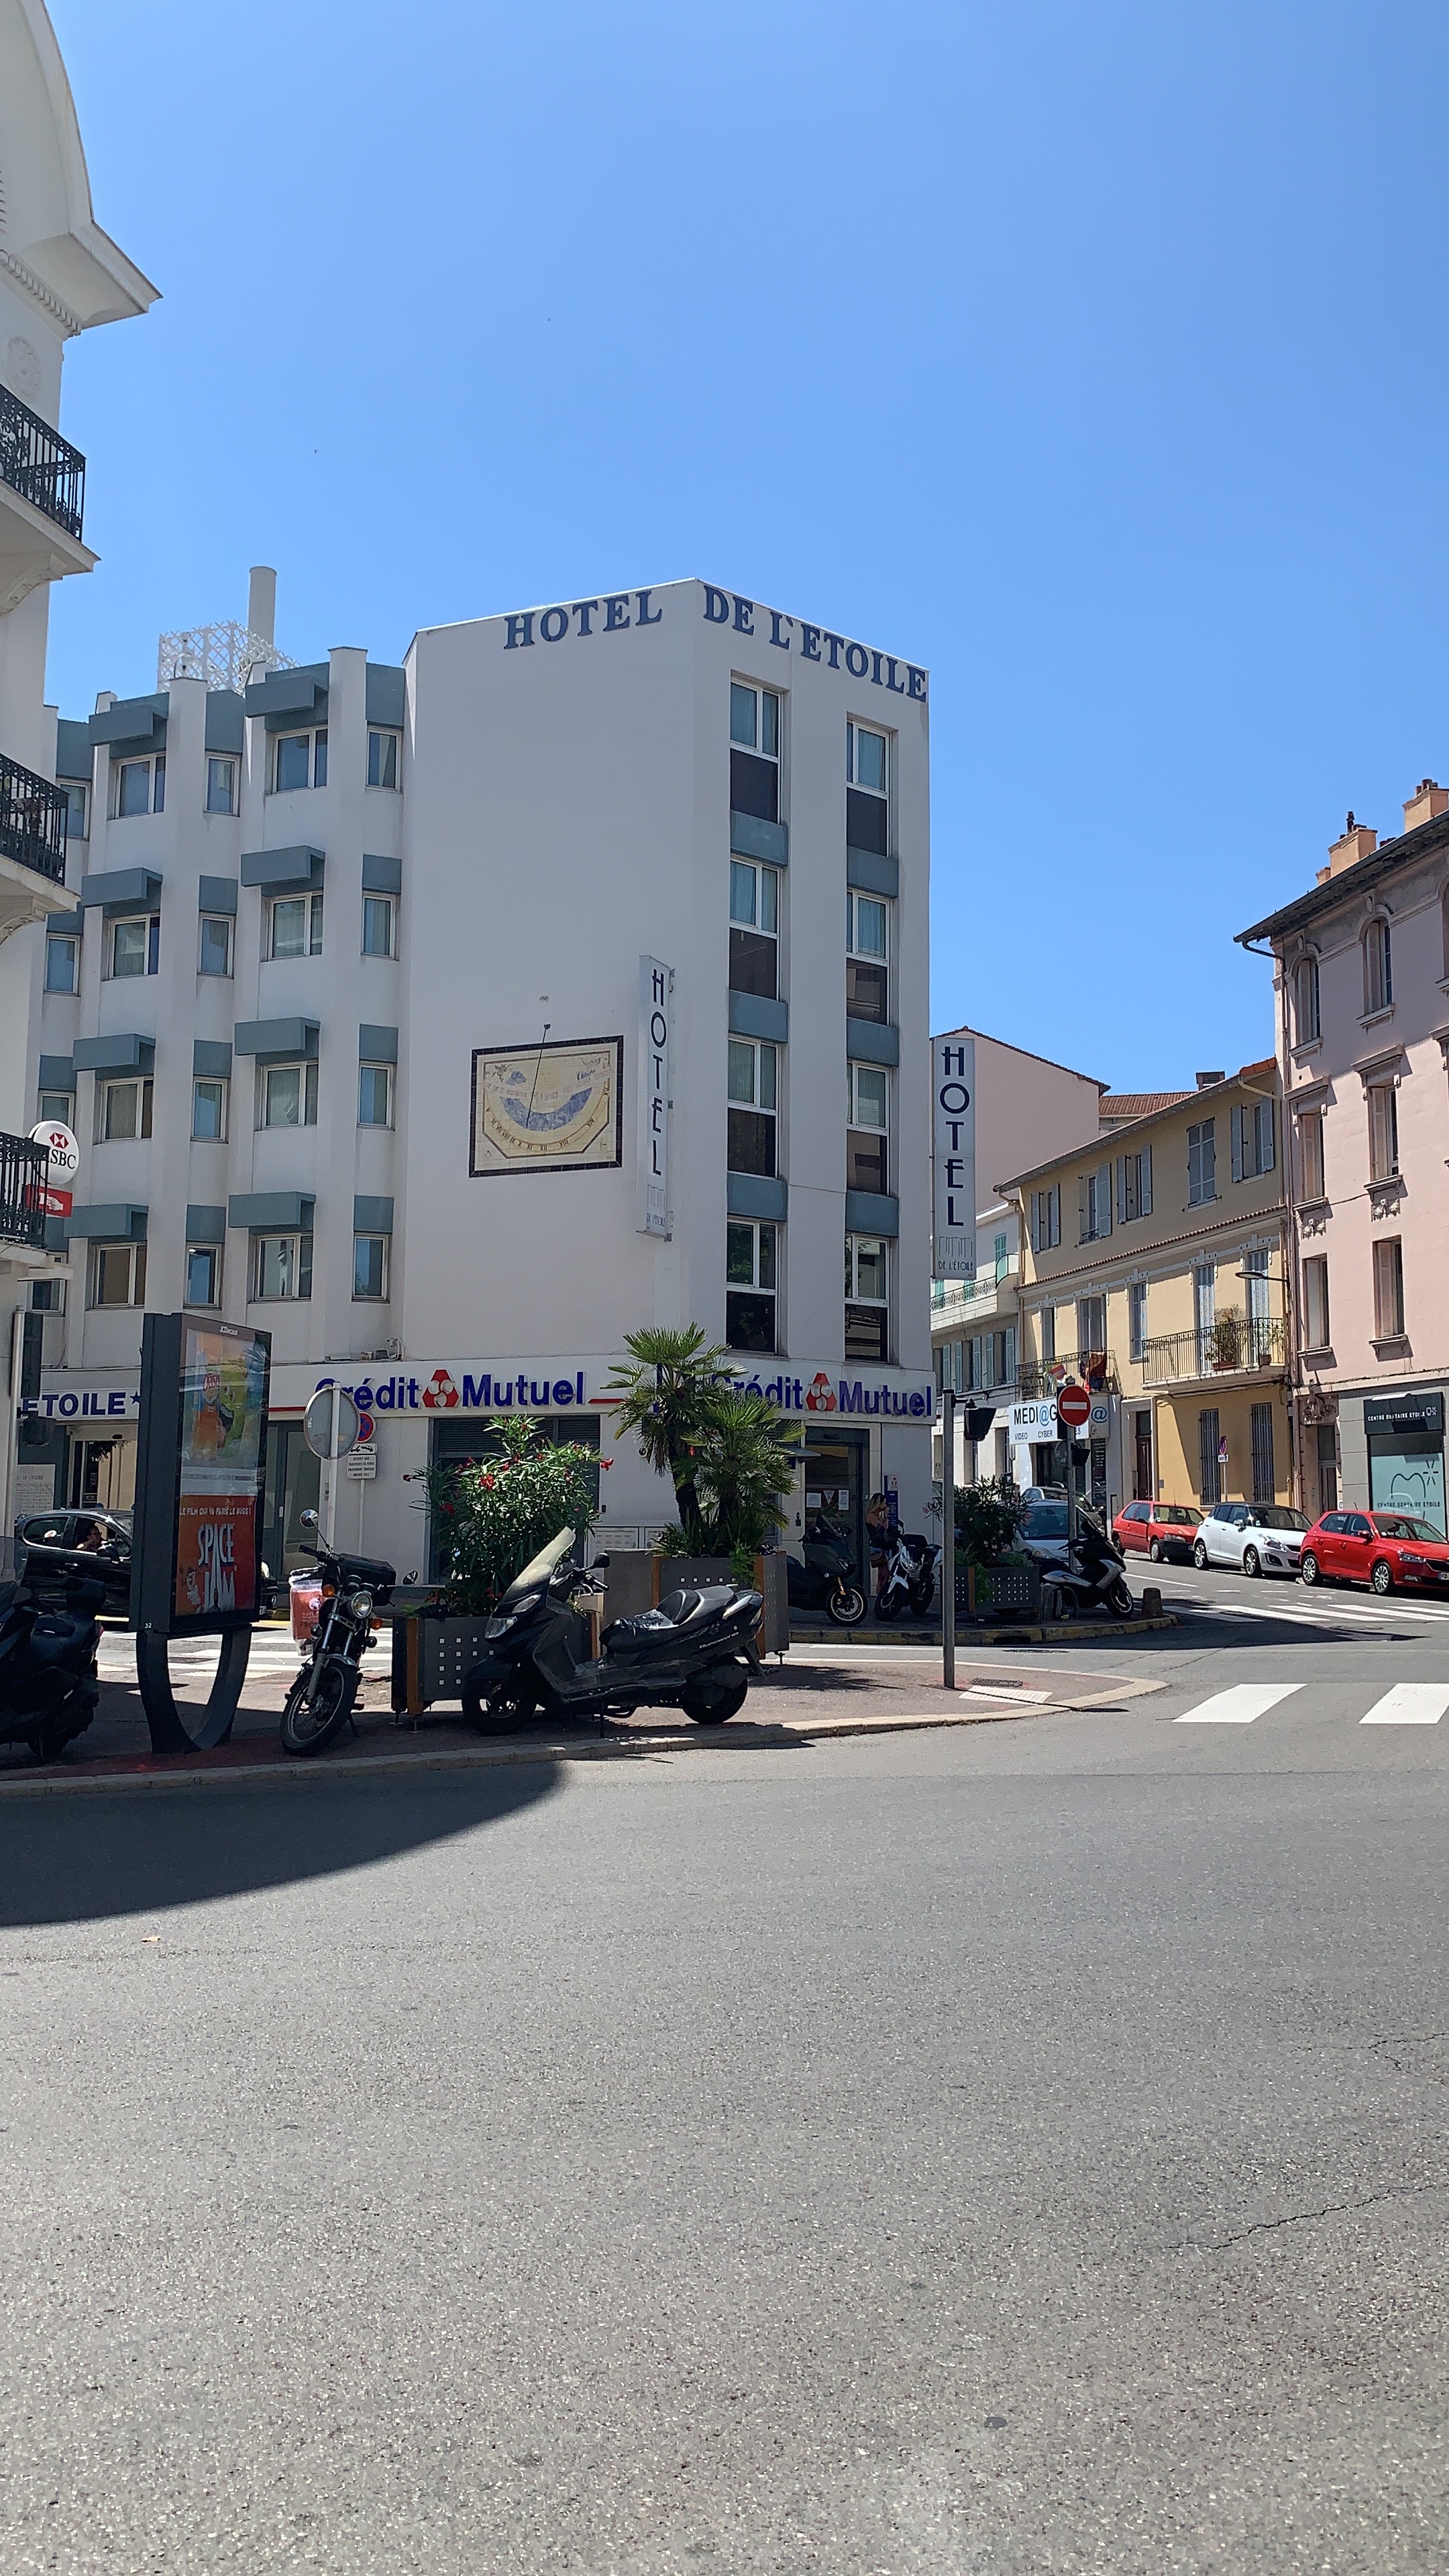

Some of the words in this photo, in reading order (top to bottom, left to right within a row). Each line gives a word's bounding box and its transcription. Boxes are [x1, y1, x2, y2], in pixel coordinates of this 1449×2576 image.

[504, 590, 663, 649] HOTEL
[703, 584, 755, 636] DE
[651, 969, 667, 1177] HOTEL
[939, 1046, 971, 1227] HOTEL
[49, 1148, 76, 1170] SBC
[938, 1260, 946, 1270] DE
[462, 1371, 584, 1407] Mutuel
[839, 1380, 932, 1417] Mutuel
[1014, 1432, 1028, 1440] VIDEO
[1038, 1430, 1053, 1439] CYBER
[1368, 1413, 1385, 1421] CENTRE
[197, 1523, 235, 1566] SPACE
